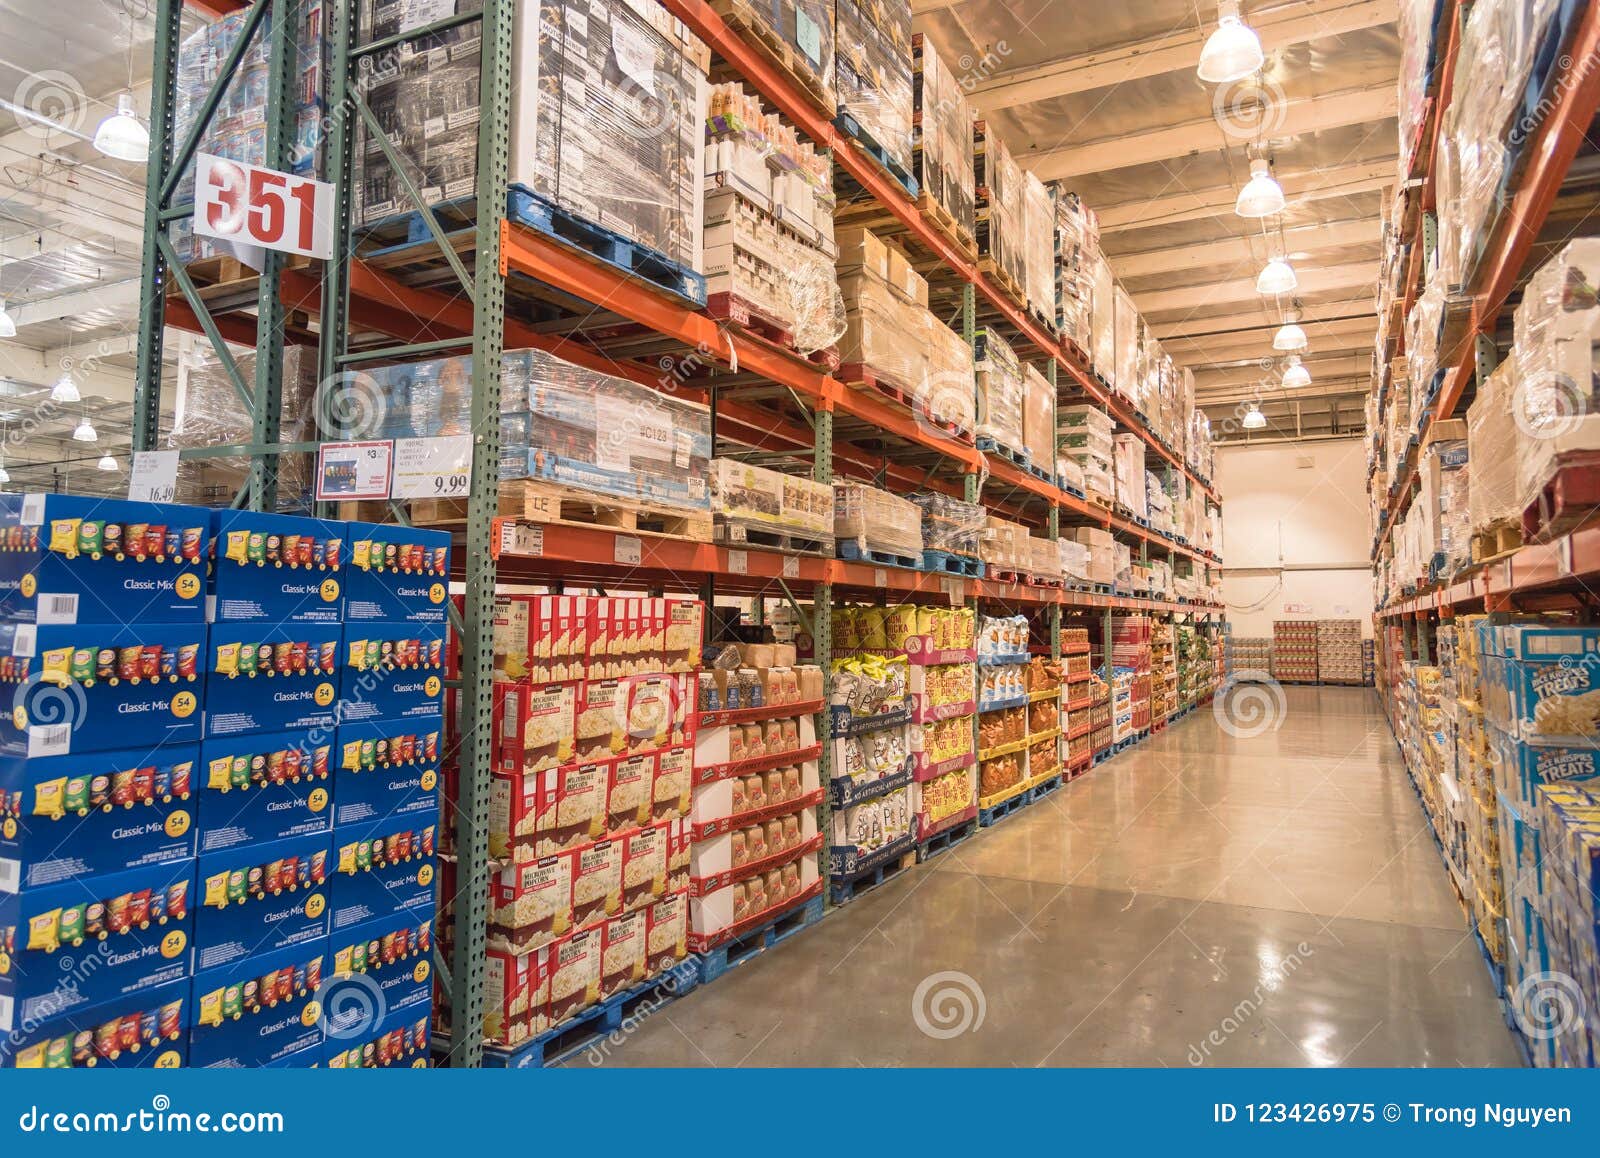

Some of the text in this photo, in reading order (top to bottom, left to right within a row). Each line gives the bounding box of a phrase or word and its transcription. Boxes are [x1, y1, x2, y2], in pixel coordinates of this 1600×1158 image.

[207, 160, 315, 250] 351
[640, 426, 666, 442] #C123
[434, 475, 466, 493] 9.99
[149, 488, 173, 501] 16.49
[124, 579, 194, 590] Classic Mix 54
[282, 584, 305, 594] Classic
[307, 585, 319, 594] Mix
[398, 588, 416, 596] Classic
[1532, 668, 1589, 688] RICE KRISPIES
[274, 689, 329, 702] Classic Mix 54
[393, 684, 411, 693] Classic
[1534, 677, 1589, 700] TREATS
[118, 698, 190, 713] Classic Mix 54
[1537, 753, 1593, 772] RICE KRISPIES
[1539, 762, 1595, 784] TREATS
[388, 781, 407, 790] Classic
[267, 802, 292, 812] Classic
[294, 799, 307, 807] Mix
[112, 816, 184, 839] Classic Mix 54
[385, 870, 430, 890] Classic Mix 54
[264, 900, 320, 923] Classic Mix 54
[107, 938, 180, 966] Classic Mix 54
[380, 966, 426, 989] Classic Mix 54
[260, 1008, 316, 1036] Classic Mix 54
